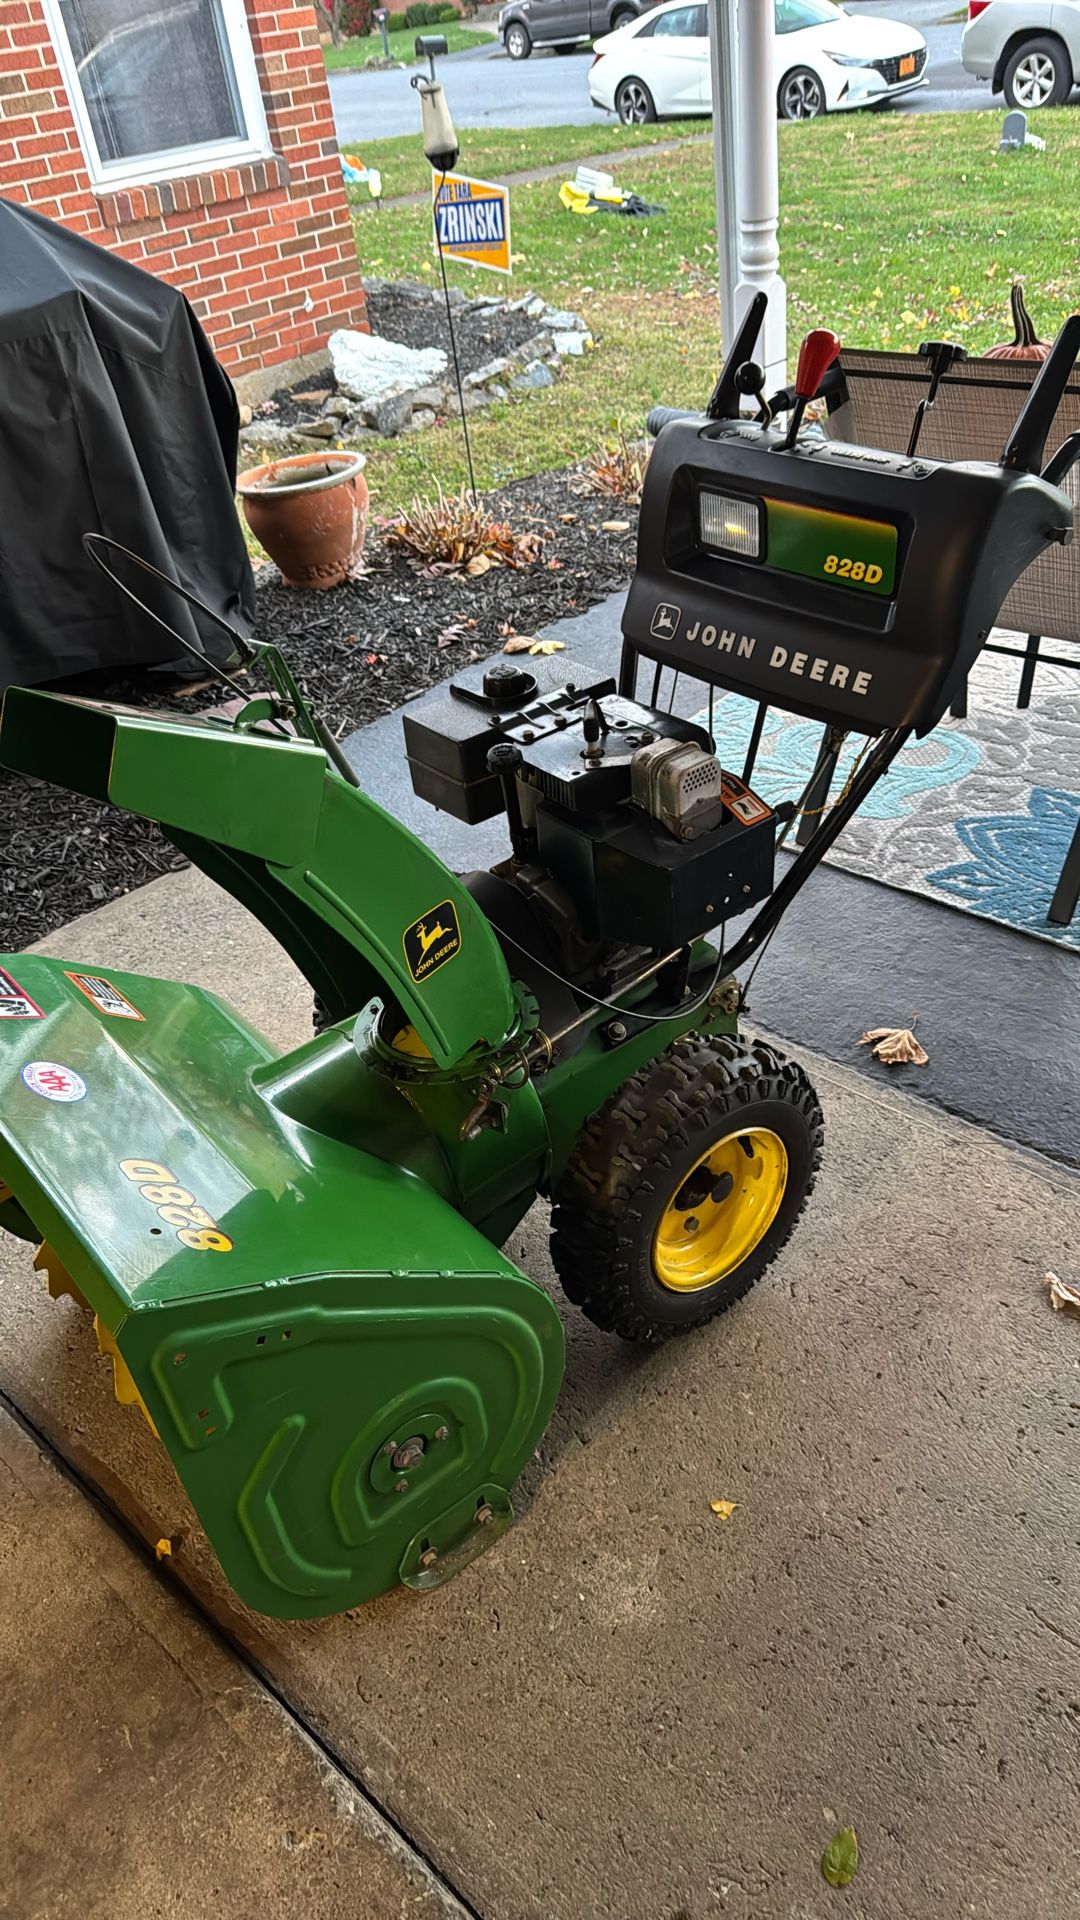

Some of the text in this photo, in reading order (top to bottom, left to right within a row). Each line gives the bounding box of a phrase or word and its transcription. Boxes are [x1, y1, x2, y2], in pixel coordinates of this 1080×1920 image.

[439, 201, 504, 243] ZRINSKI
[823, 555, 883, 585] 828D
[686, 621, 873, 695] JOHN DEERE
[415, 938, 458, 977] JOHN DEERE
[38, 1070, 72, 1092] AAA
[118, 1158, 234, 1252] 828D
